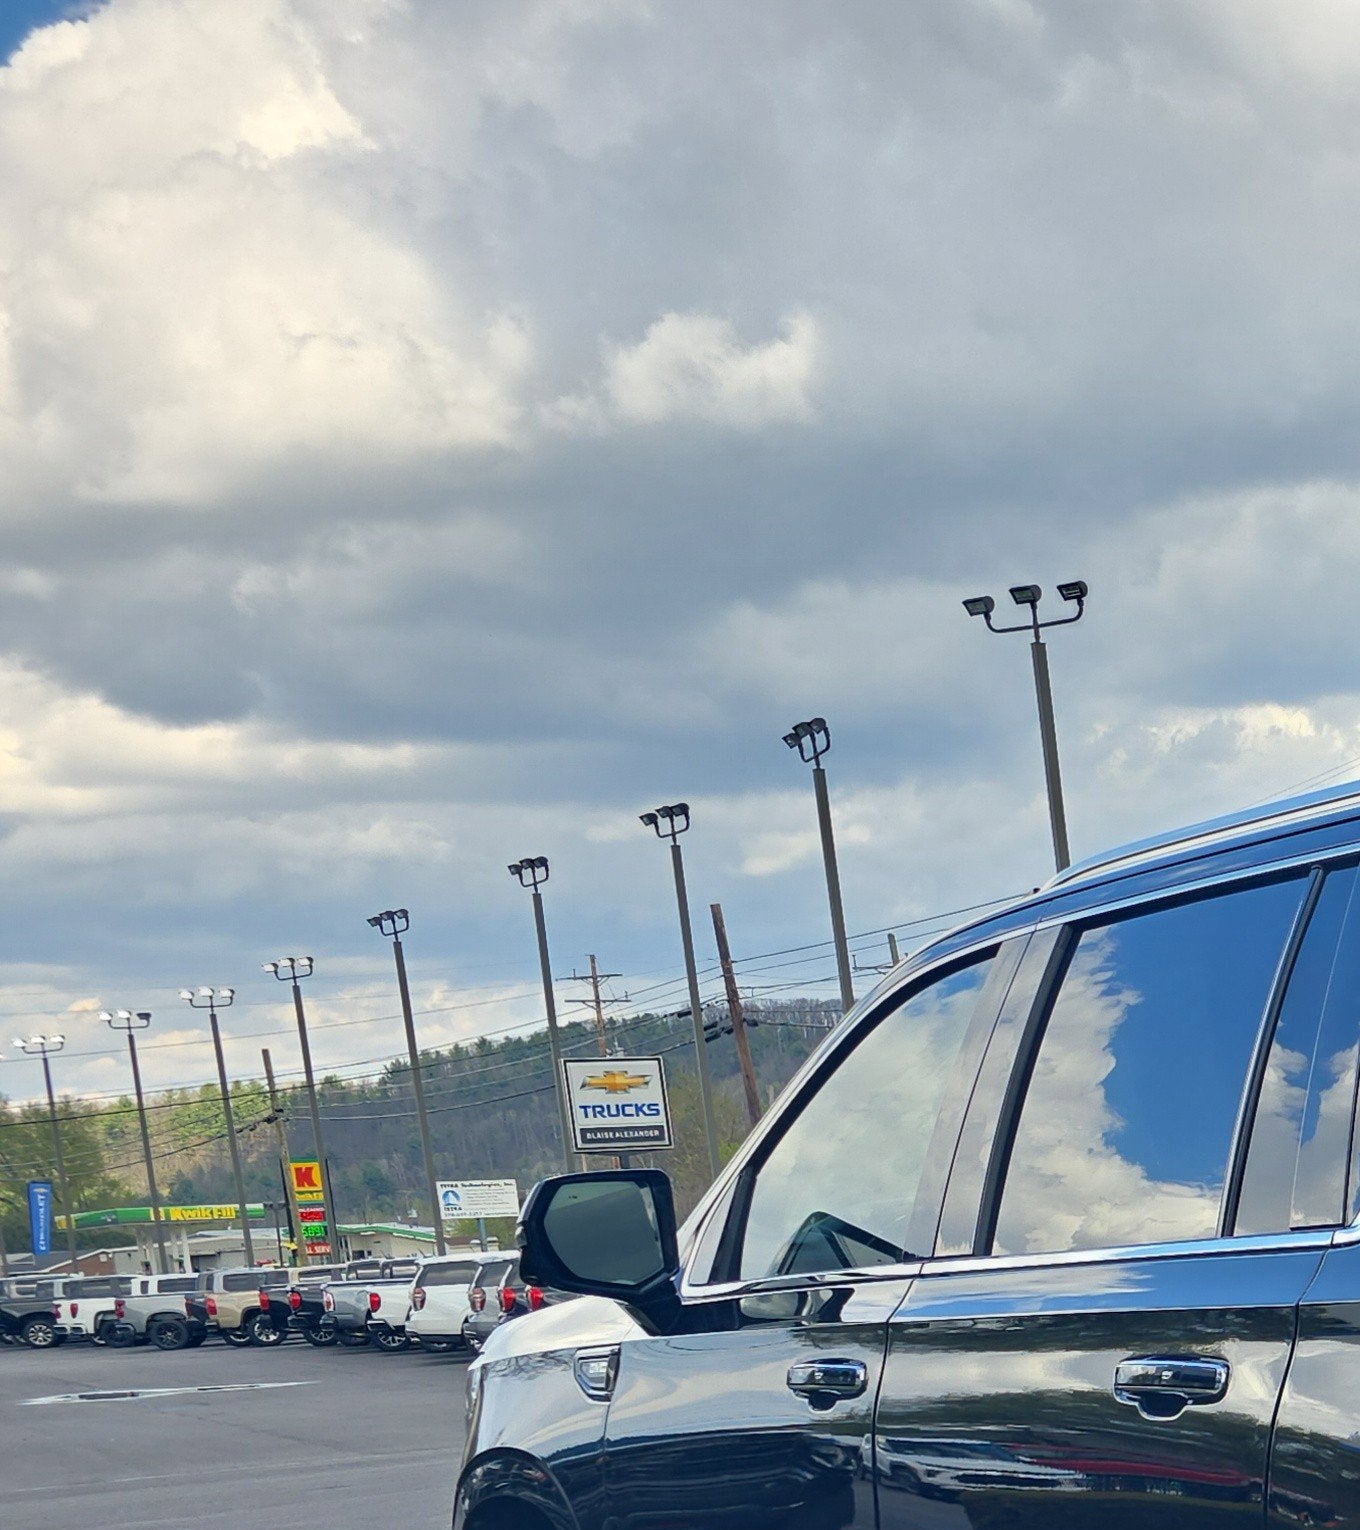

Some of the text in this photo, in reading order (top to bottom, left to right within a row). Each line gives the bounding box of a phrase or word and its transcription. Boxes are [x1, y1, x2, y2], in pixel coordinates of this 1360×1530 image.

[579, 1103, 660, 1118] TRUCKS
[586, 1130, 660, 1139] BLAISE ALEXANDER
[294, 1167, 318, 1187] K
[170, 1206, 235, 1220] Kwik Fill
